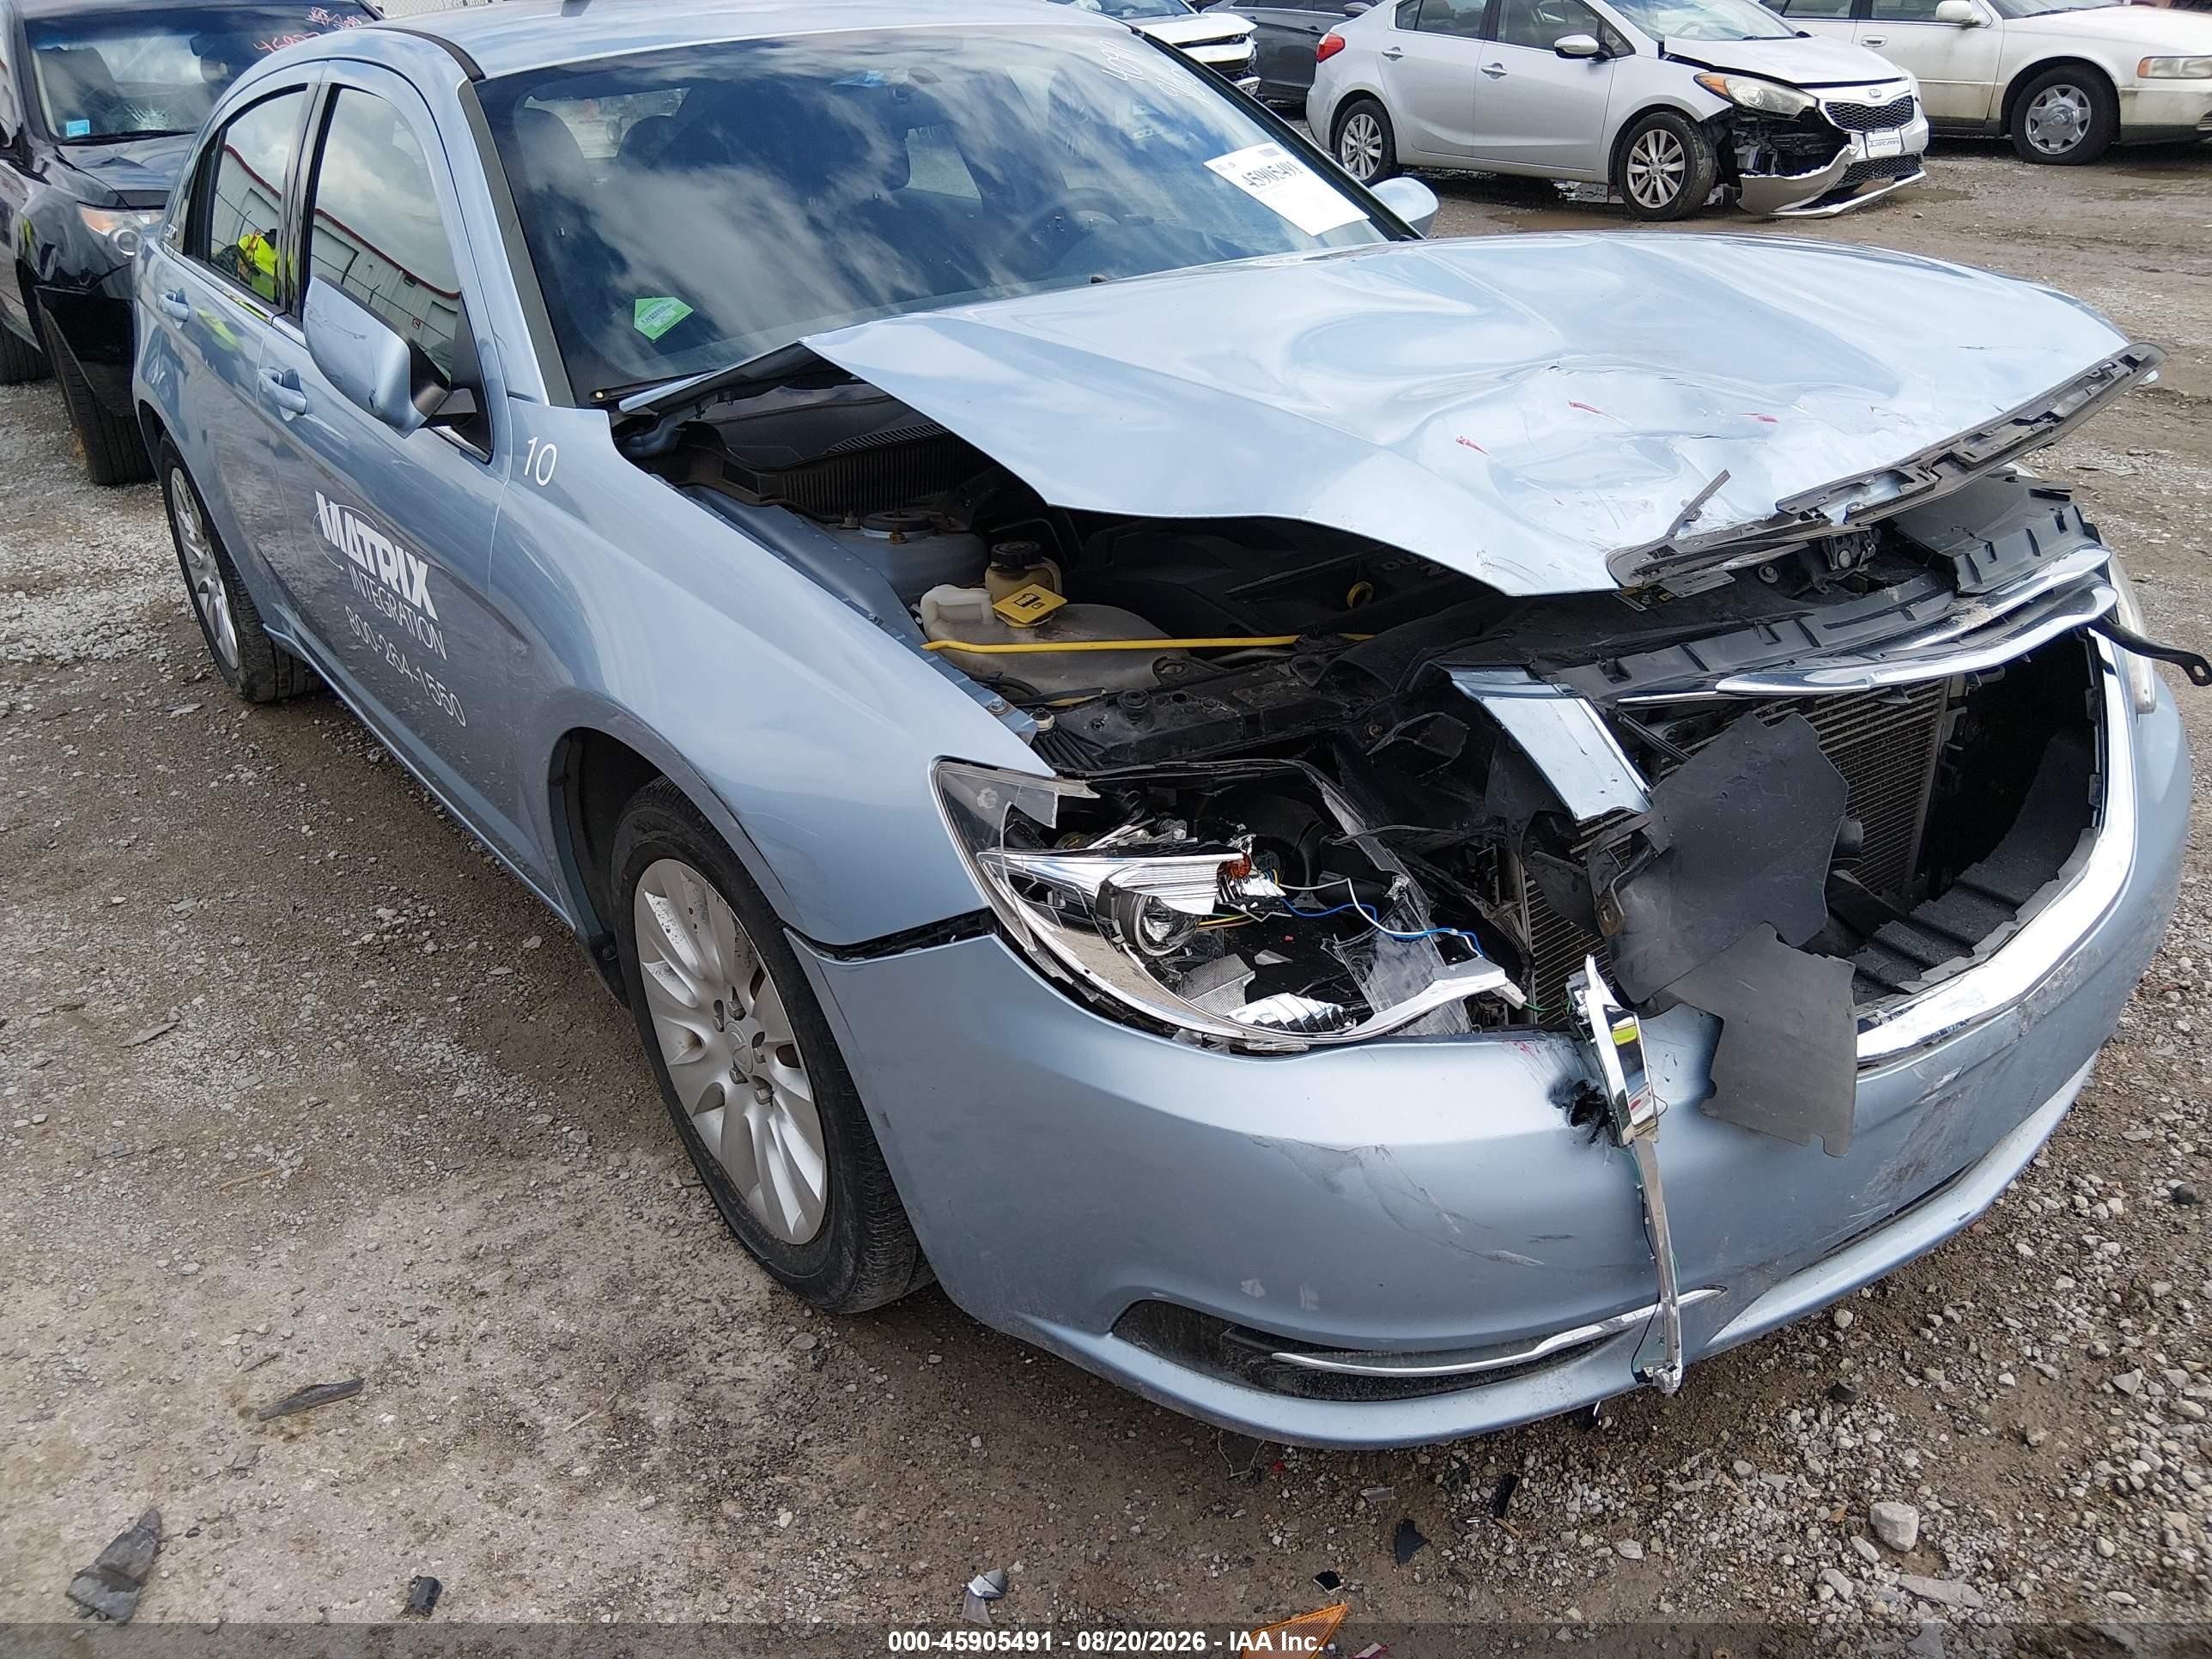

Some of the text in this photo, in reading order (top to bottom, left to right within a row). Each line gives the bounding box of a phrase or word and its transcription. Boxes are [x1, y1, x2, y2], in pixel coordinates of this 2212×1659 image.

[1241, 161, 1303, 188] 45905491
[524, 436, 557, 486] 10
[315, 489, 439, 622] MATRIX
[348, 563, 447, 660] INTEGRATION
[345, 605, 466, 728] 800-264-1550
